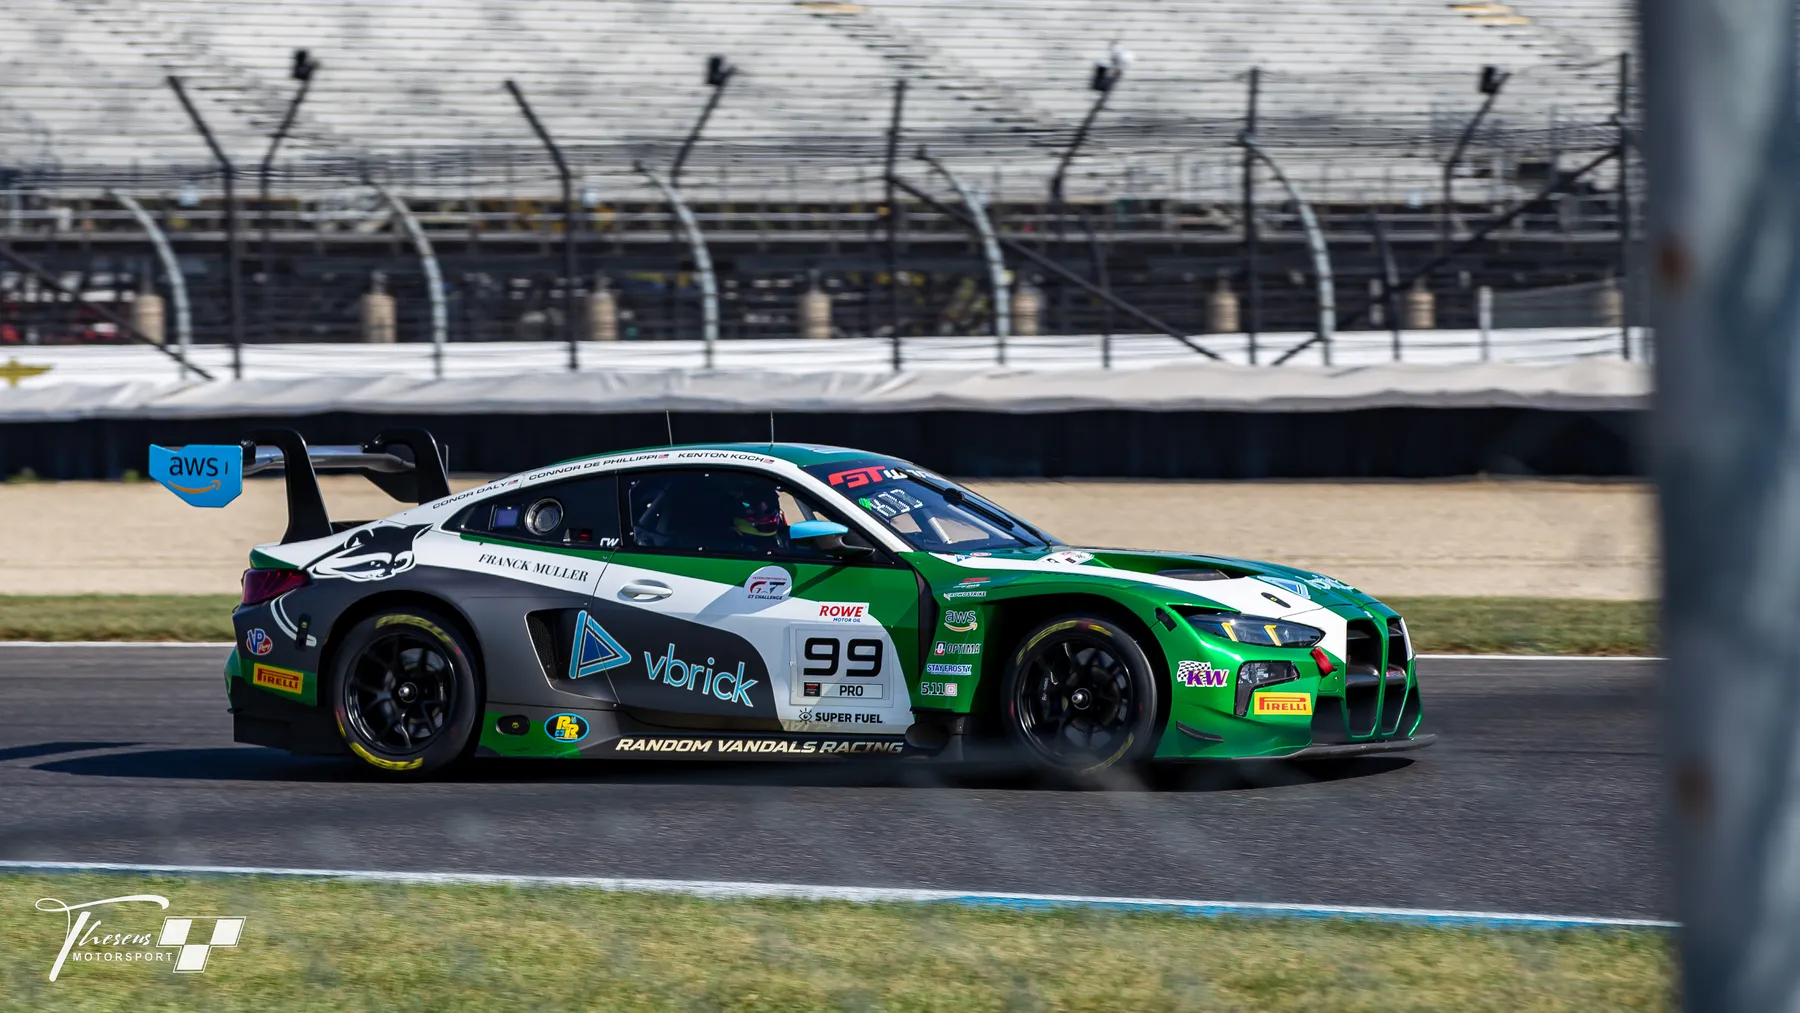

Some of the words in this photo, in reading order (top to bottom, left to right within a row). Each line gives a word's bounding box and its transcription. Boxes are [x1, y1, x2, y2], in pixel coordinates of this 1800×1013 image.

[730, 453, 765, 463] KOCH
[169, 456, 219, 477] aws
[529, 465, 580, 480] CONNOR
[603, 455, 657, 465] PHILLIPPI
[828, 466, 885, 488] GT
[433, 492, 474, 509] CONOR
[477, 482, 507, 494] DALY
[478, 552, 530, 572] FRANCK
[532, 558, 589, 583] MULLER
[819, 606, 864, 617] ROWE
[945, 610, 976, 623] aws
[947, 643, 980, 655] OPTIMA
[803, 637, 884, 678] 99
[643, 643, 759, 707] vbrick
[927, 664, 943, 673] STAY
[944, 665, 971, 673] FROSTY
[256, 668, 300, 689] PIRELLI
[839, 685, 863, 697] PRO
[1259, 697, 1307, 711] PIRELLI
[815, 712, 852, 722] SUPER
[855, 713, 883, 724] FUEL
[615, 738, 712, 753] RANDOM
[717, 740, 818, 754] VANDALS
[818, 741, 904, 754] RACING
